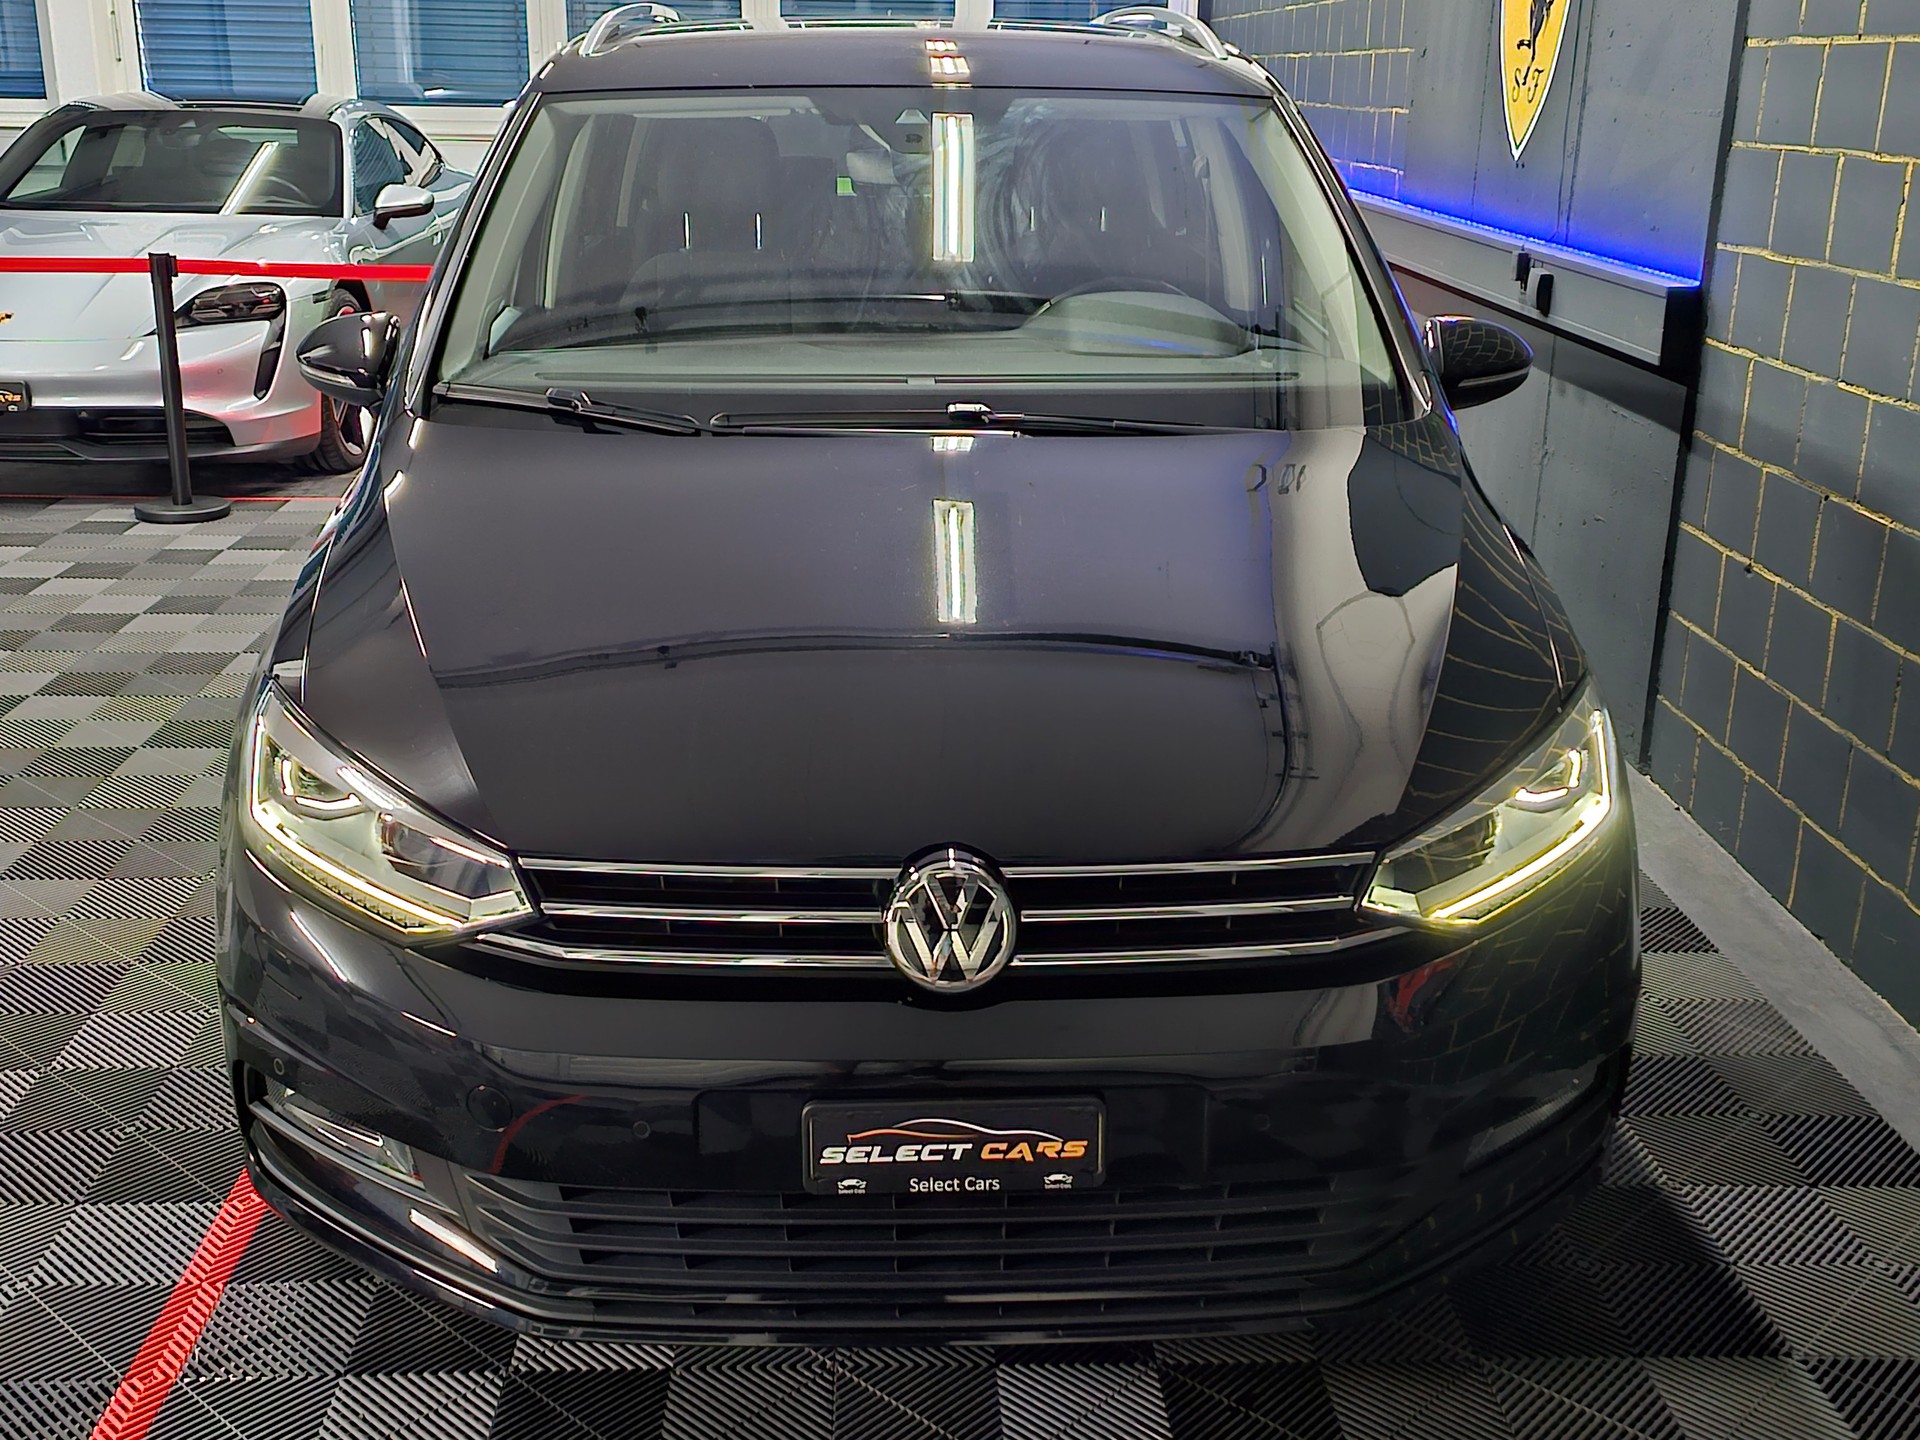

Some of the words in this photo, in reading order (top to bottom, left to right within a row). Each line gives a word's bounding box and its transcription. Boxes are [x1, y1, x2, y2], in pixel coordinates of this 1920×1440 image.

[820, 1143, 973, 1164] SELECT
[980, 1140, 1089, 1162] CARS
[909, 1177, 960, 1192] Select
[964, 1176, 1000, 1192] Cars
